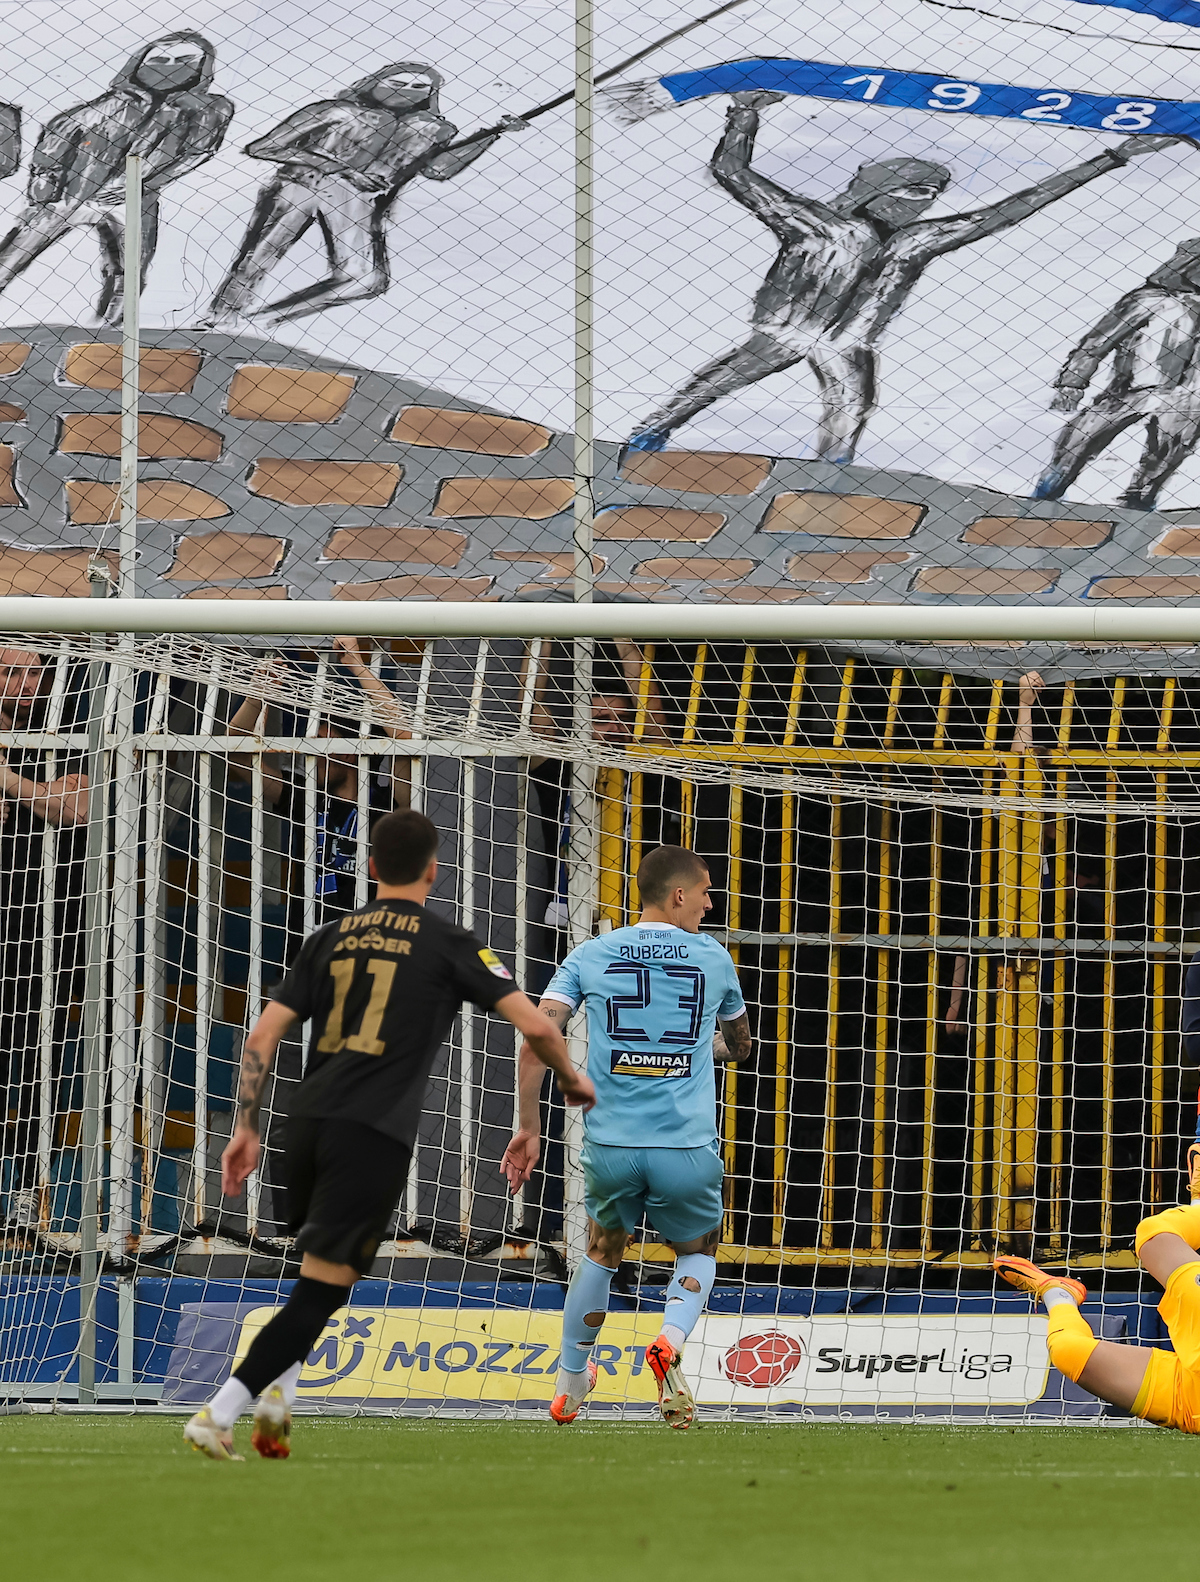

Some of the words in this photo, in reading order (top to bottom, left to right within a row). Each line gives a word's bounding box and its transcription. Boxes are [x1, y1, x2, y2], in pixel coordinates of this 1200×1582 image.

[842, 73, 1157, 134] 1928
[339, 910, 420, 934] ВУКОТИЋ
[316, 957, 398, 1056] 11
[603, 962, 706, 1046] 23
[617, 1052, 690, 1068] ADMIRAL
[665, 1067, 689, 1077] BET
[383, 1340, 647, 1377] MOZZRT
[815, 1347, 1013, 1380] SuperLiga
